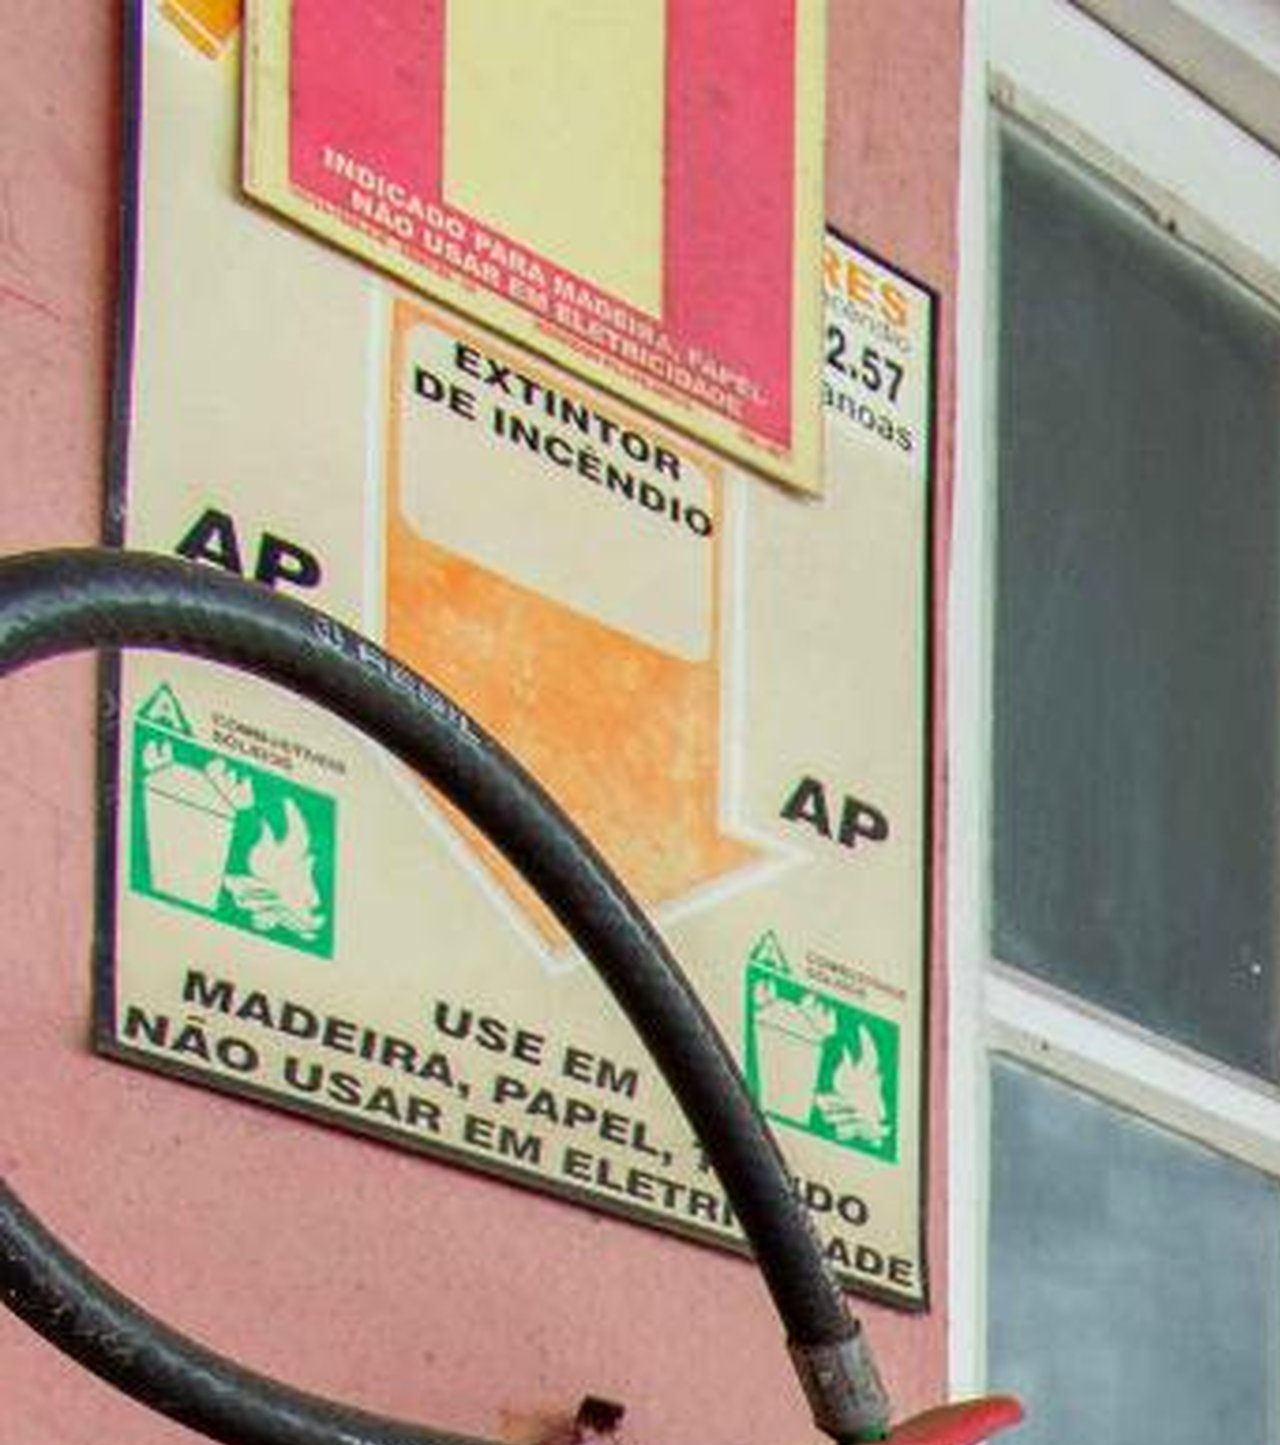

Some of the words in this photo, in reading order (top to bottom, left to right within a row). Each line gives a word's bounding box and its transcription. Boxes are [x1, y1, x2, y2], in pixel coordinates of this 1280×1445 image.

[323, 147, 465, 240] INDICADO
[475, 233, 548, 288] PARA
[423, 230, 498, 288] USAR
[510, 276, 548, 313] EM
[556, 303, 745, 417] ELETRICIDADE
[414, 365, 476, 420] DE
[495, 409, 714, 537] INCÊNDIO
[456, 342, 680, 480] EXTINTOR
[176, 508, 321, 588] AP
[780, 776, 889, 848] AP
[123, 1006, 260, 1073] NÃO
[283, 1056, 441, 1132] USAR
[464, 1113, 541, 1164] EM
[183, 970, 470, 1099] MADEIRA,
[493, 1074, 674, 1167] PAPEL,
[435, 1001, 544, 1066] USE
[563, 1048, 640, 1099] EM
